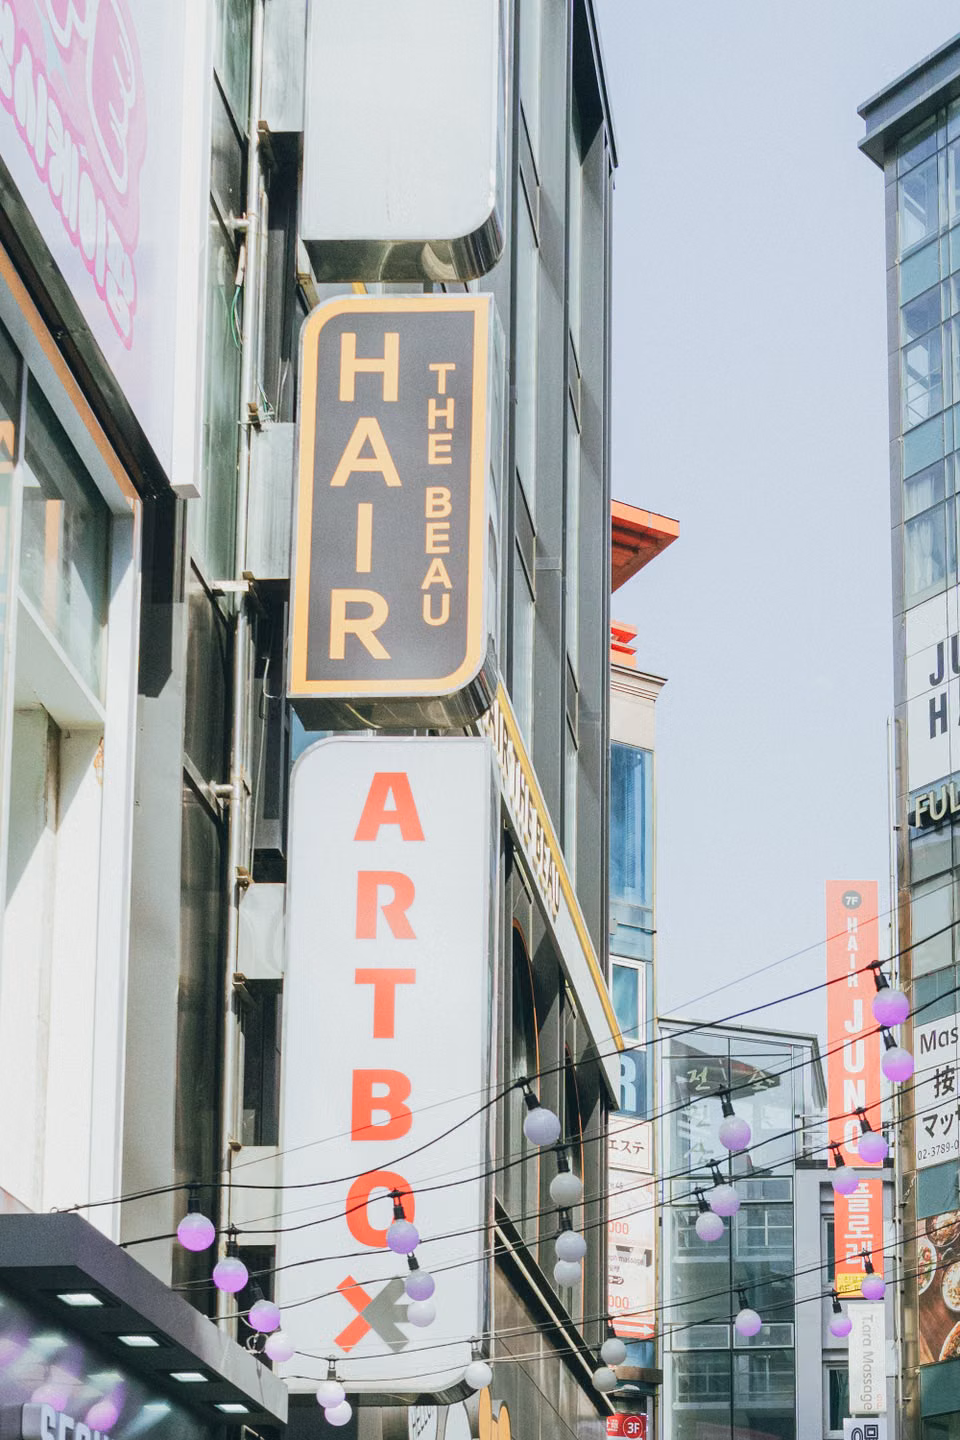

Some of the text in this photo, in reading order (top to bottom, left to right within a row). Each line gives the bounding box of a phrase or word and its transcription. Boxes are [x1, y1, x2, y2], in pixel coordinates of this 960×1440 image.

[426, 362, 456, 465] THE
[328, 331, 403, 661] HAIR
[421, 486, 453, 626] BEAU
[845, 895, 859, 906] 7F
[847, 917, 858, 988] HAIR
[334, 771, 425, 1354] ARTBOX
[859, 1314, 874, 1411] T.ara Massage
[627, 1421, 640, 1434] 3F
